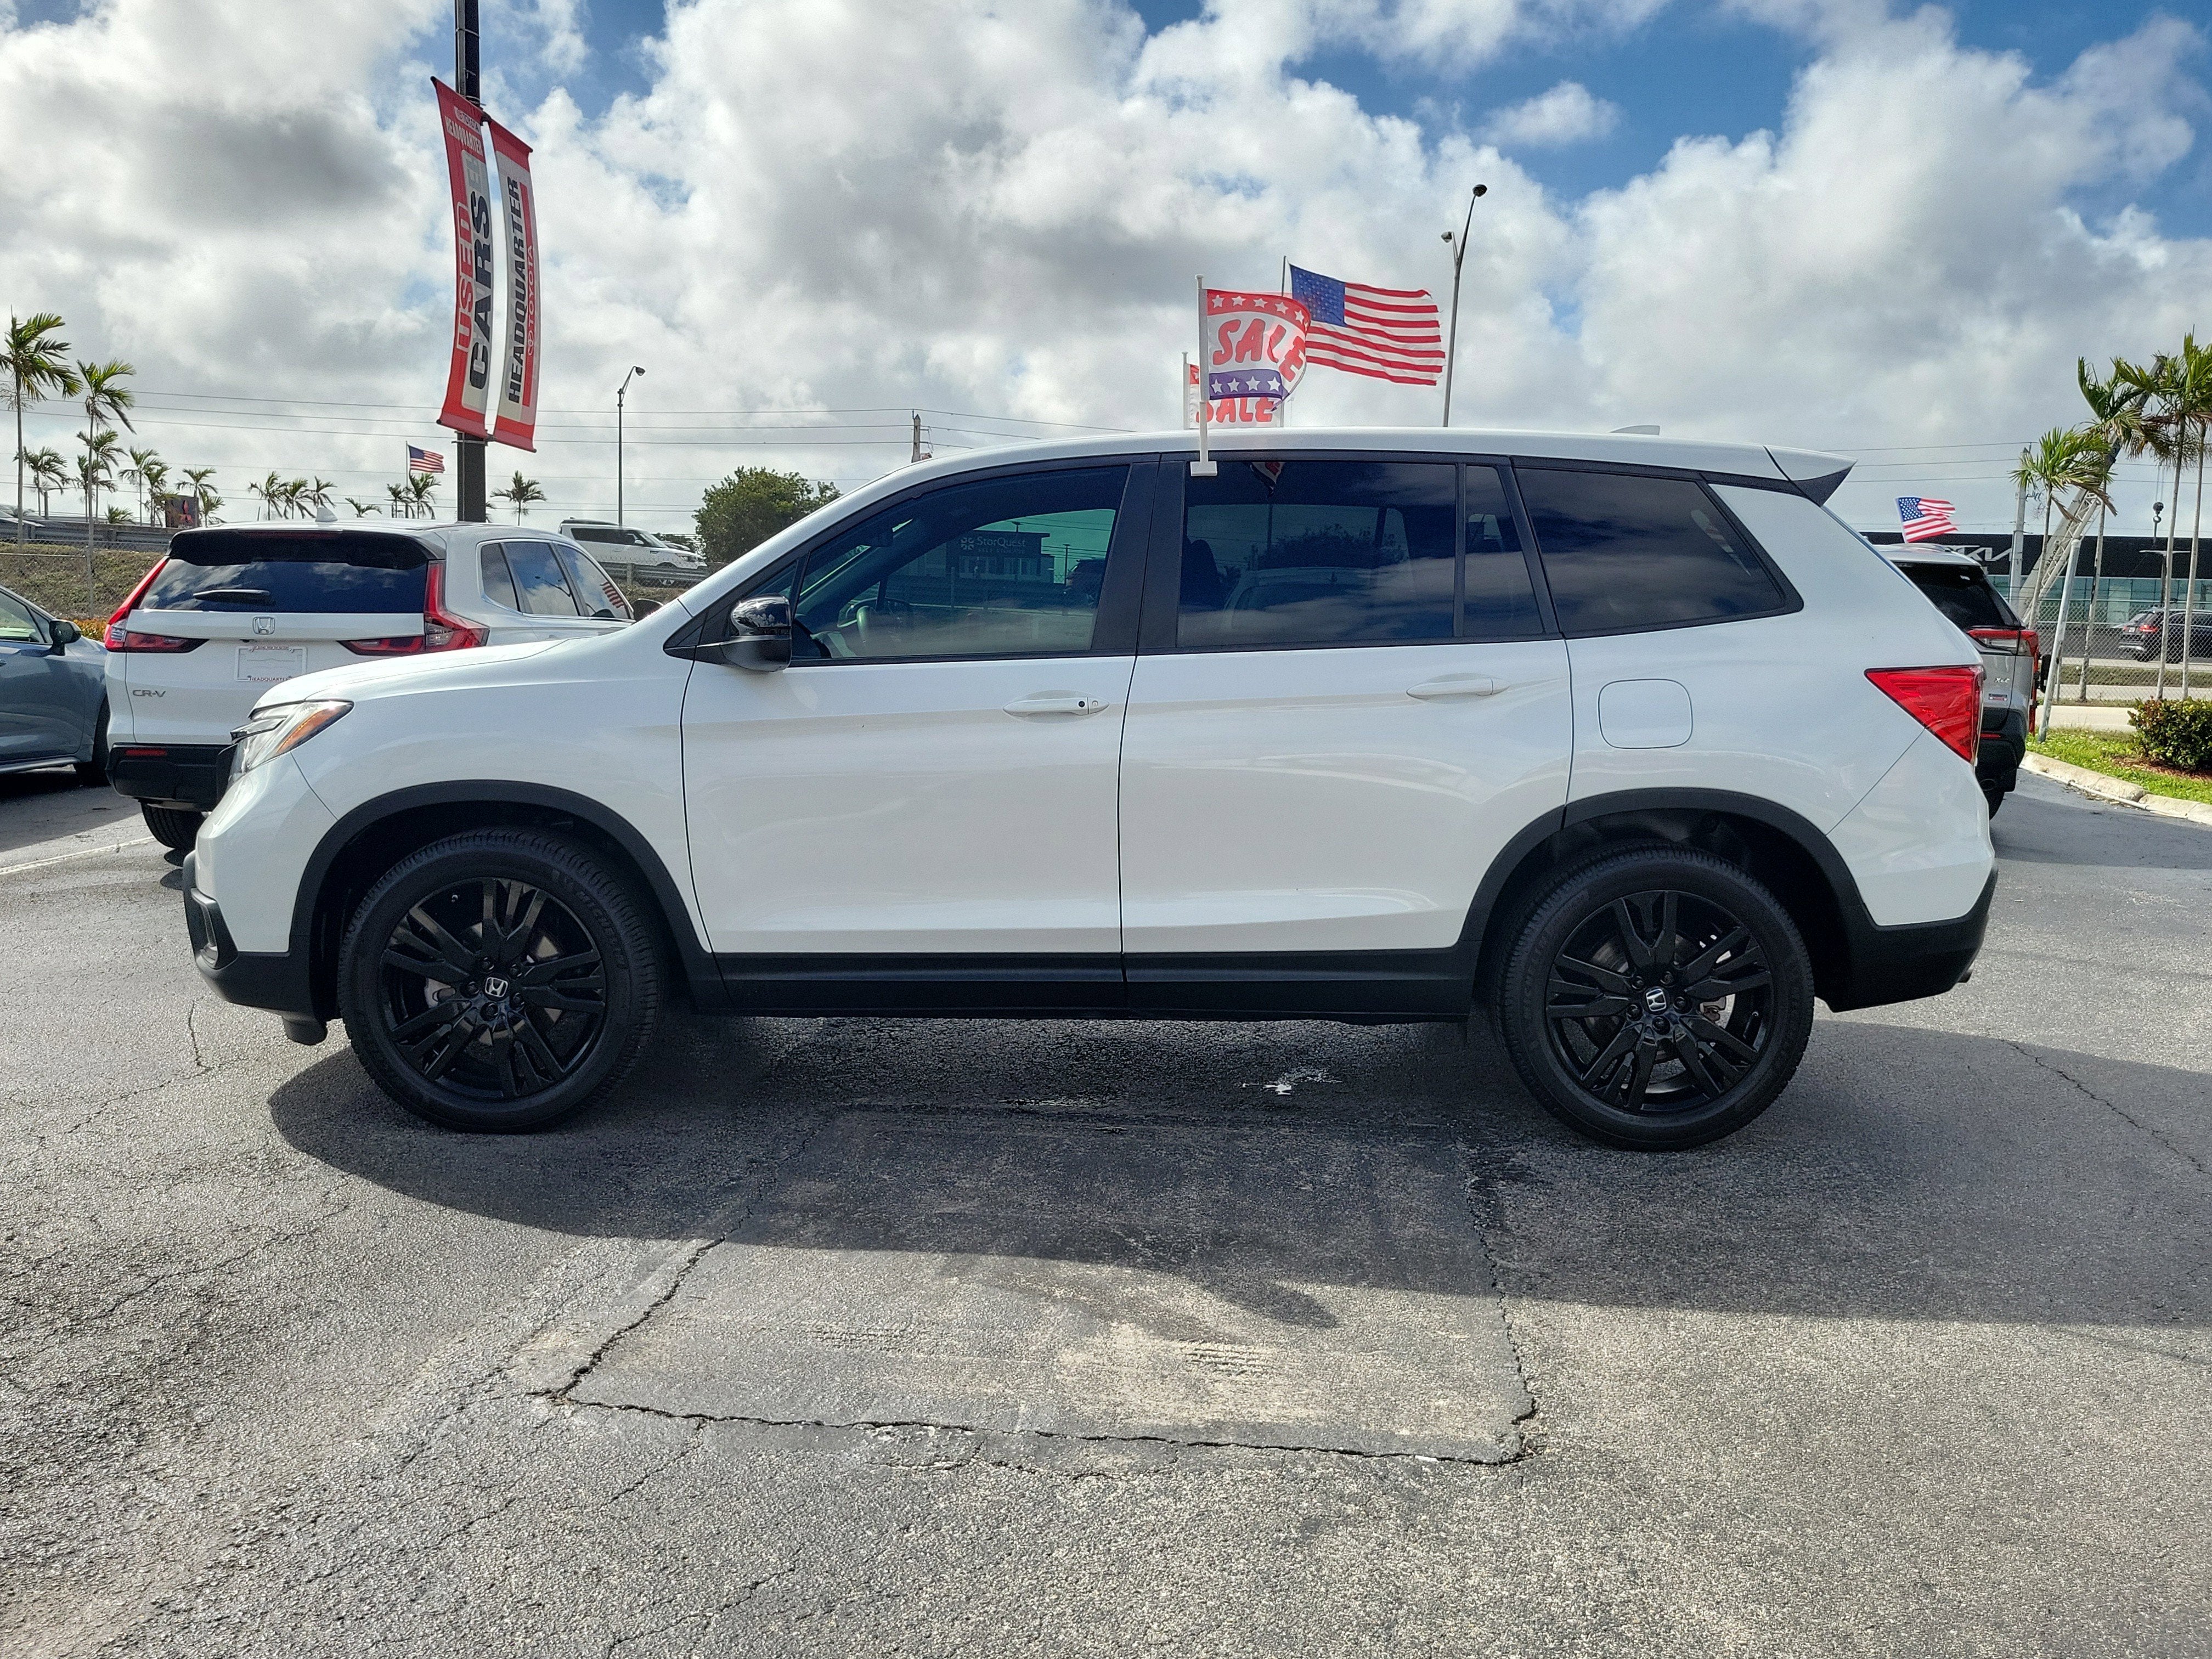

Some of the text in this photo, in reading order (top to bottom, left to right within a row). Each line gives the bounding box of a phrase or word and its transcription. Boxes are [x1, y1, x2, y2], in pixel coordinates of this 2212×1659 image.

[445, 115, 483, 156] HEADQUARTER
[456, 201, 473, 353] USED
[470, 191, 492, 390] CARS
[507, 176, 526, 404] HEADQUARTER
[527, 245, 535, 328] TOYOTA
[1212, 318, 1305, 382] SALE
[977, 536, 1026, 548] StorQuest
